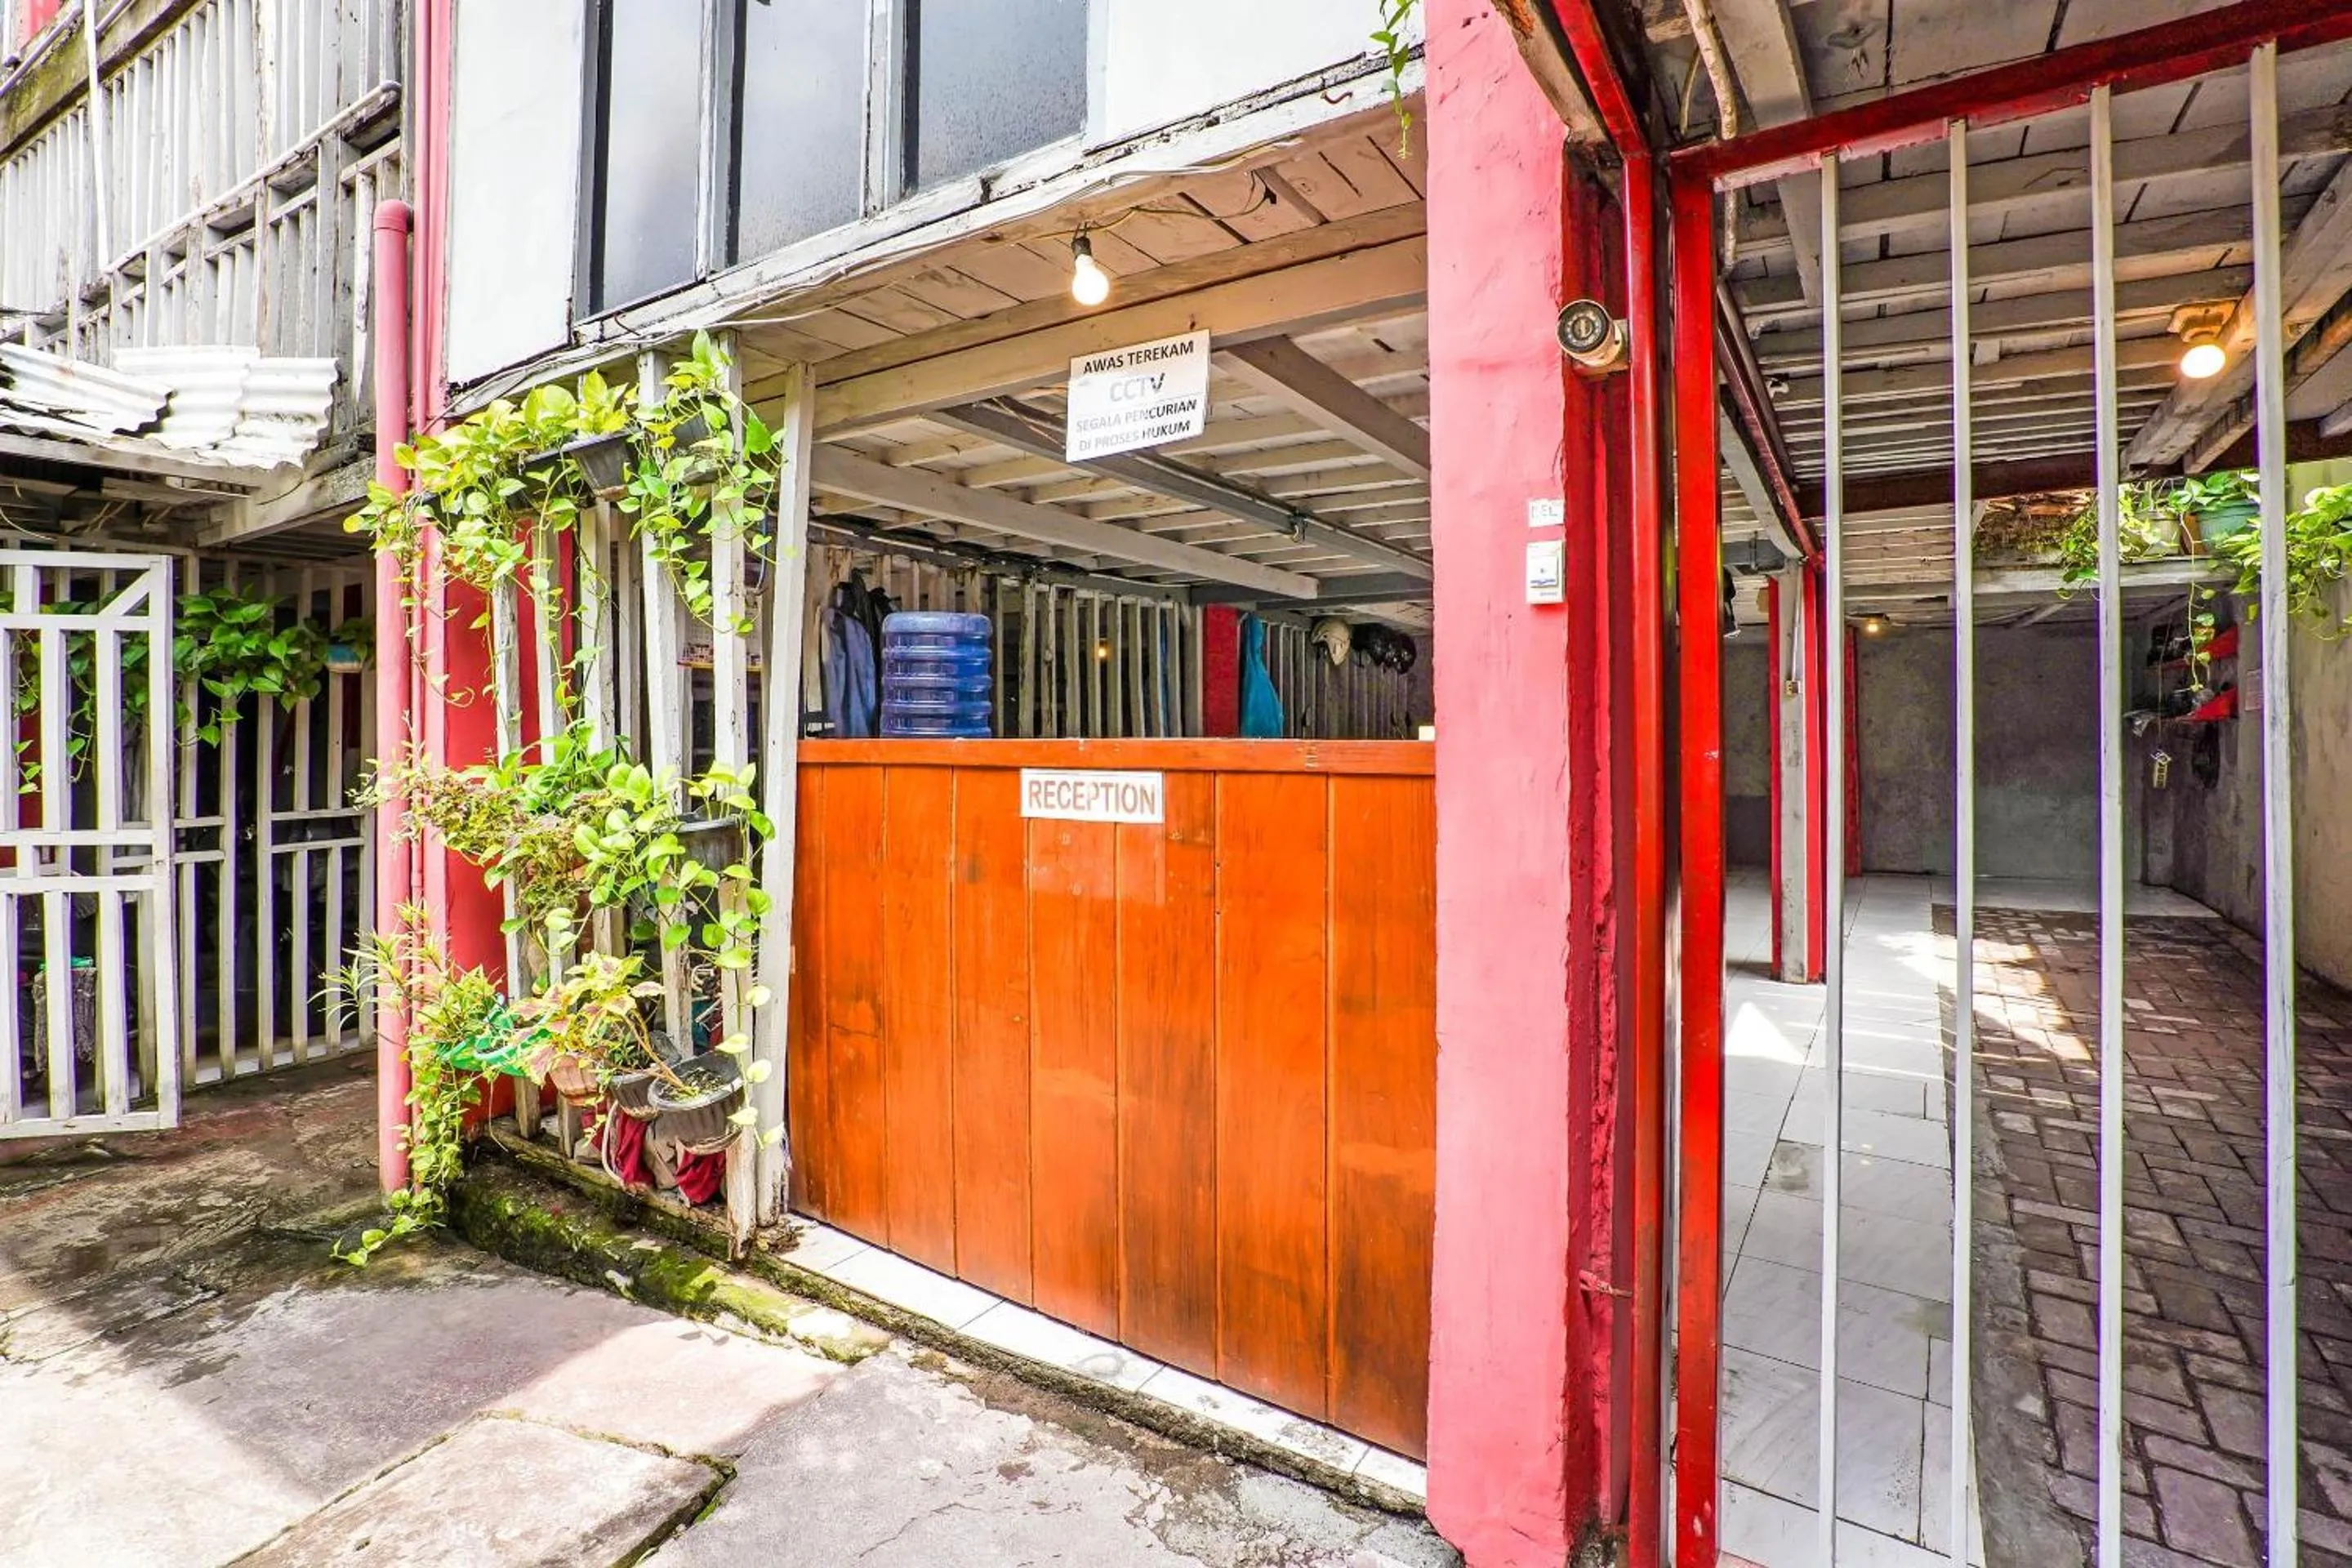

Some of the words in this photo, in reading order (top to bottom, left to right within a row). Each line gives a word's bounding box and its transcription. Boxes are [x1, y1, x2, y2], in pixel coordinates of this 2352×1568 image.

[1083, 354, 1124, 374] AWAS
[1127, 340, 1194, 366] TEREKAM
[1109, 372, 1166, 403] CCTV
[1076, 413, 1121, 434] SEGALA
[1125, 399, 1198, 422] PENCURIAN
[1079, 439, 1092, 452] DI
[1094, 430, 1140, 449] PROSES
[1142, 420, 1192, 440] HUKUM
[1027, 780, 1156, 815] RECEPTION
